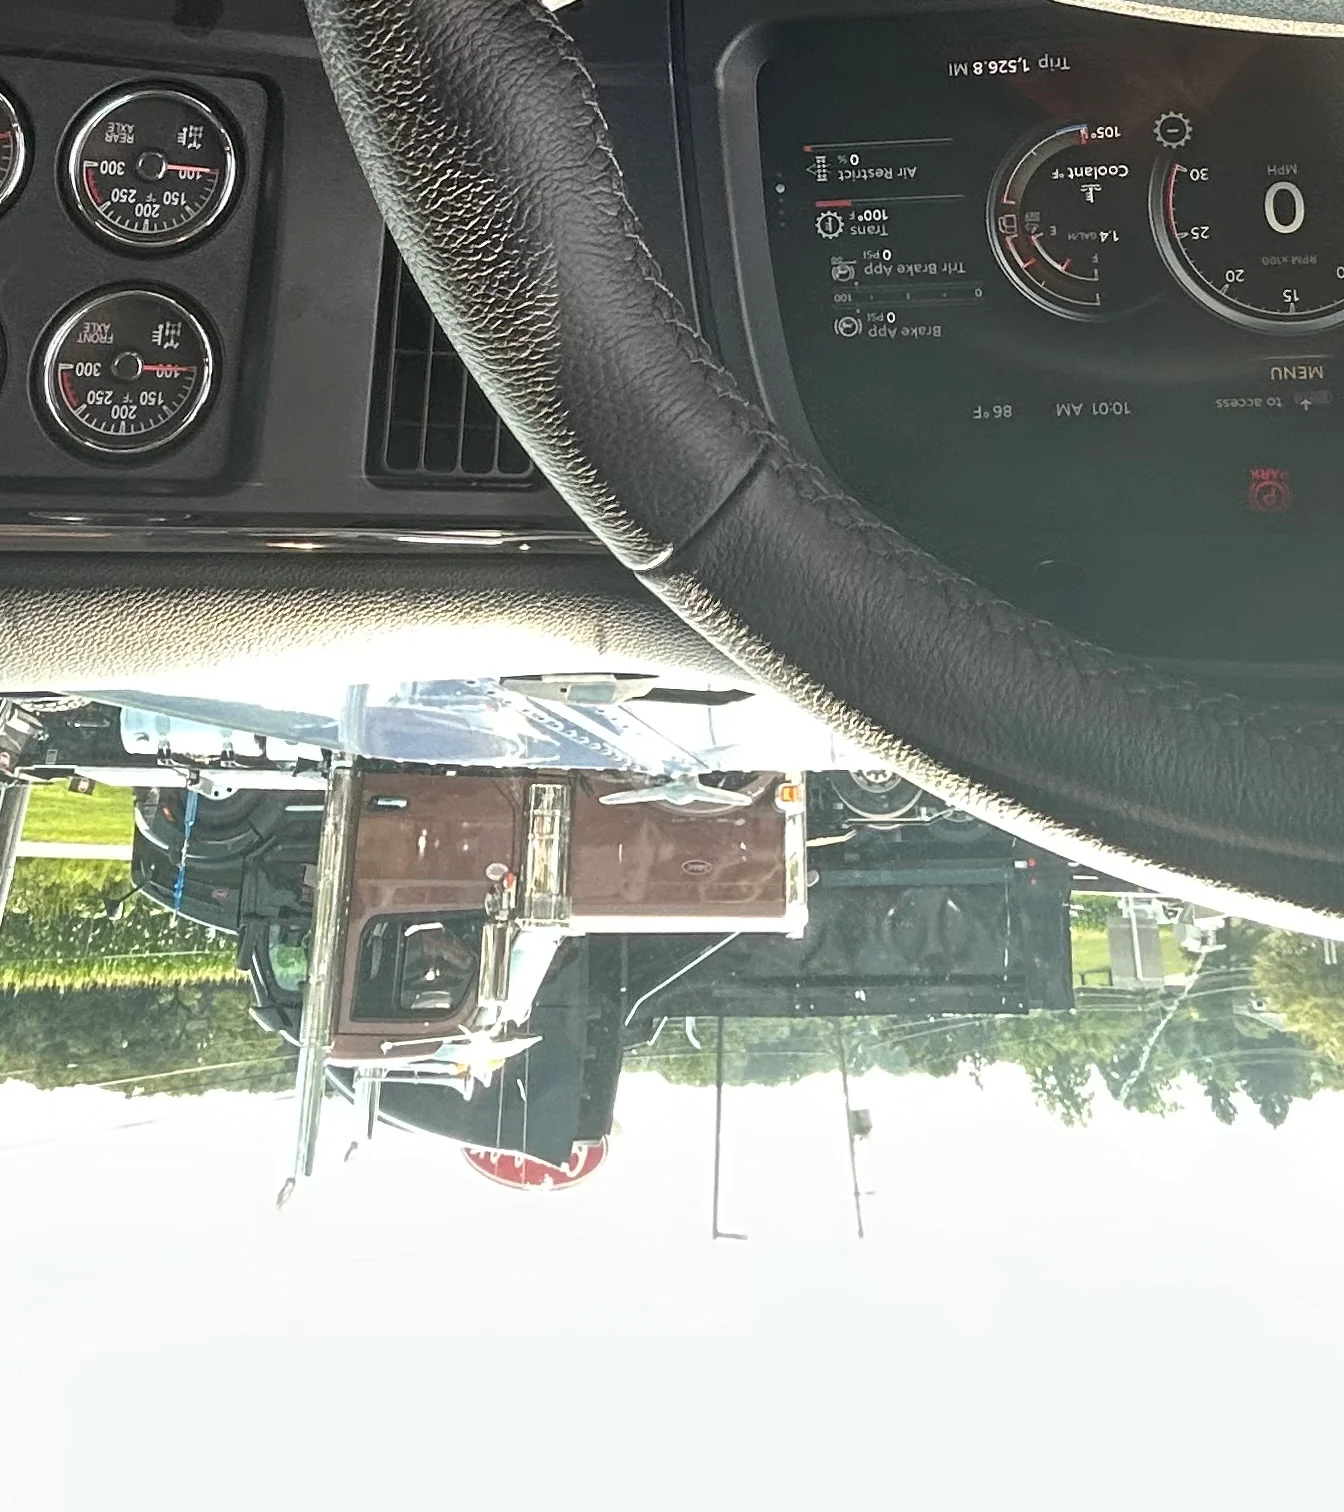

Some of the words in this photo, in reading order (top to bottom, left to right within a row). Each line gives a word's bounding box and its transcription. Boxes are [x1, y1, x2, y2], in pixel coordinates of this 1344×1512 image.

[972, 57, 1030, 75] 1,526.8
[1038, 53, 1071, 71] Trip
[948, 62, 968, 76] MI
[107, 122, 135, 133] AXLE
[1090, 125, 1121, 139] 105°
[104, 132, 134, 144] REAR
[837, 154, 848, 164] %
[849, 154, 860, 166] 0
[100, 160, 126, 175] 300
[897, 166, 917, 179] Air
[1067, 164, 1129, 180] Coolant
[1267, 163, 1298, 176] MPH
[837, 167, 893, 182] Restrict
[1189, 168, 1209, 181] 30
[111, 188, 137, 203] 250
[163, 191, 187, 205] 150
[135, 203, 160, 218] 200
[1264, 181, 1305, 234] 0
[848, 211, 855, 220] F
[857, 208, 888, 222] 100°
[849, 225, 888, 236] Trans
[1049, 225, 1057, 235] E
[1067, 231, 1097, 241] GAL/H
[1190, 226, 1210, 240] 25
[863, 249, 880, 259] PSI
[882, 249, 892, 261] 0
[1261, 255, 1287, 266] x100
[1291, 254, 1317, 264] RPM
[863, 261, 893, 276] App
[897, 263, 937, 275] Brake
[941, 261, 966, 274] Trlr
[1225, 268, 1245, 282] 20
[833, 292, 852, 303] 100
[974, 288, 982, 298] 0
[1282, 289, 1300, 302] 15
[867, 312, 884, 322] PSI
[887, 311, 896, 323] 0
[84, 322, 111, 333] AXLE
[868, 323, 897, 338] App
[901, 325, 942, 338] Brake
[77, 332, 114, 344] FRONT
[75, 362, 101, 376] 300
[1270, 365, 1324, 380] MENU
[87, 390, 113, 405] 250
[139, 391, 164, 405] 150
[1215, 397, 1263, 409] access
[1266, 397, 1282, 408] to
[111, 405, 137, 419] 200
[992, 404, 1013, 418] 86
[1056, 402, 1084, 416] AM
[1091, 401, 1131, 415] 10:01
[1250, 468, 1288, 480] PARK
